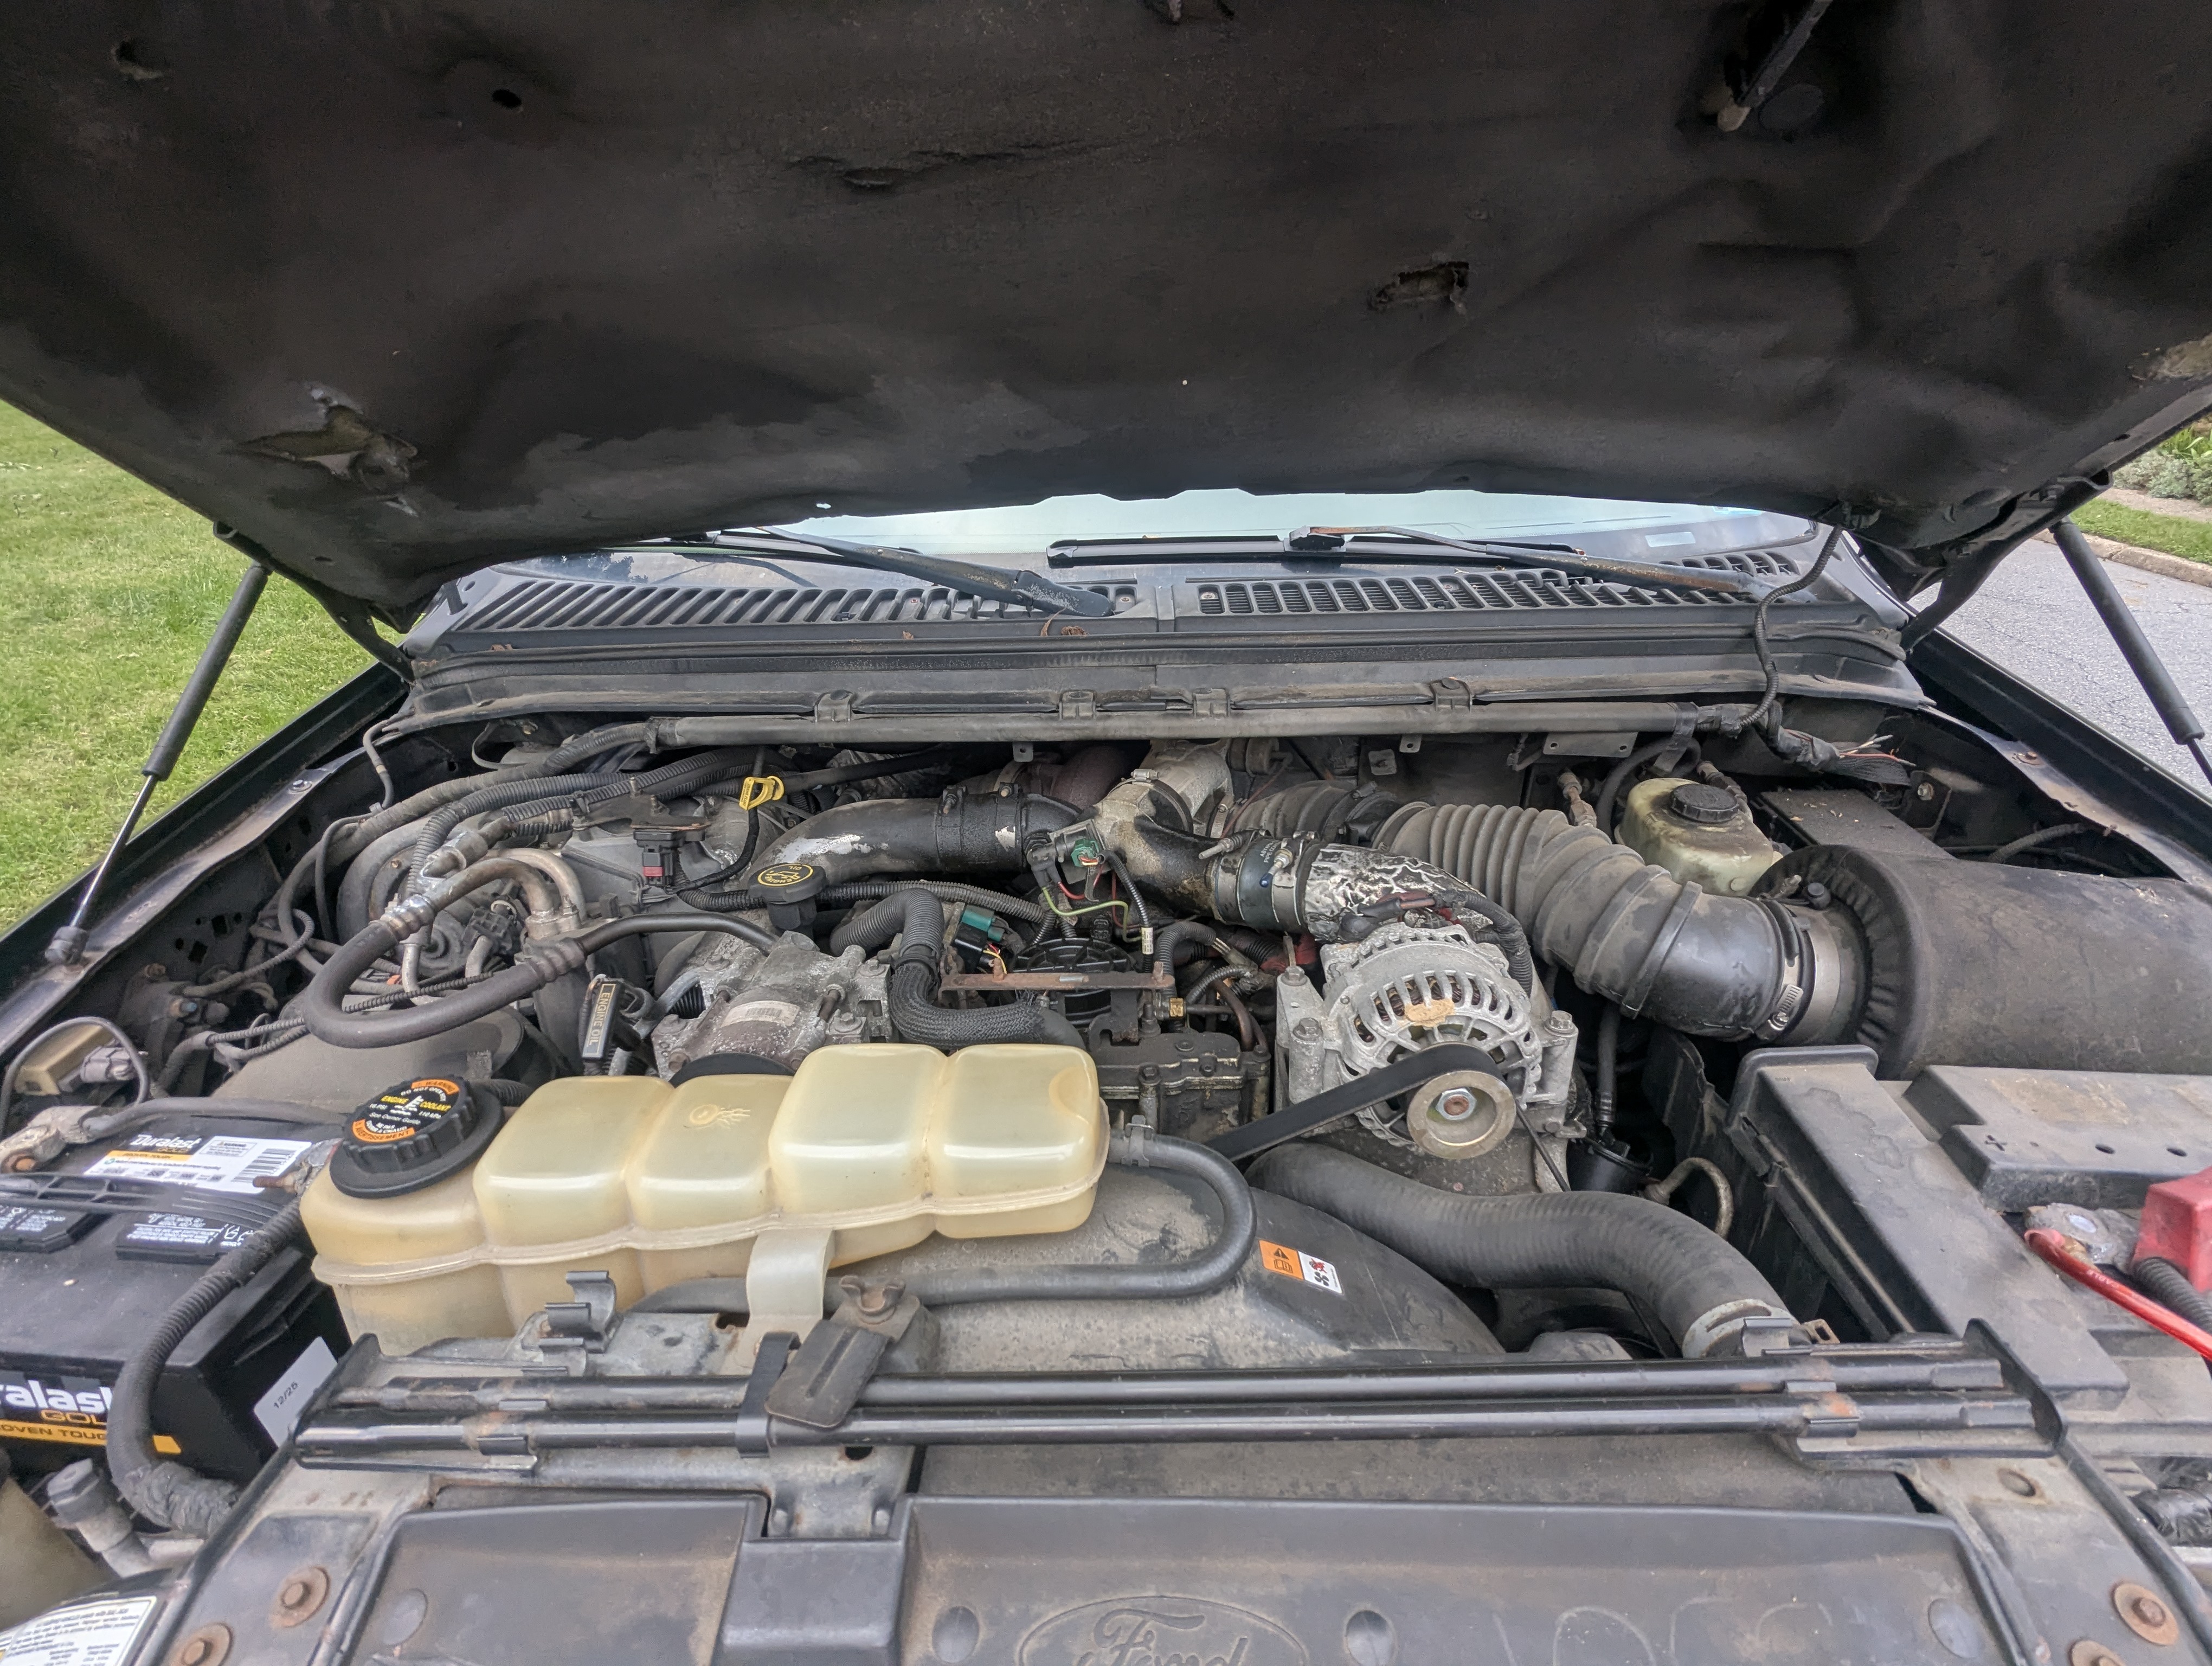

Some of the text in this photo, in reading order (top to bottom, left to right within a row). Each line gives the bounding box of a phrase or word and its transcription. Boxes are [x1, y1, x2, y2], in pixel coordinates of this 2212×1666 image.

[589, 992, 611, 1045] ENGINE OIL
[381, 1095, 452, 1112] ENGINE COOLANT
[130, 1134, 202, 1149] Duralast
[0, 1380, 113, 1414] alas
[41, 1409, 107, 1425] GOL
[0, 1424, 107, 1439] OVEN TOUG
